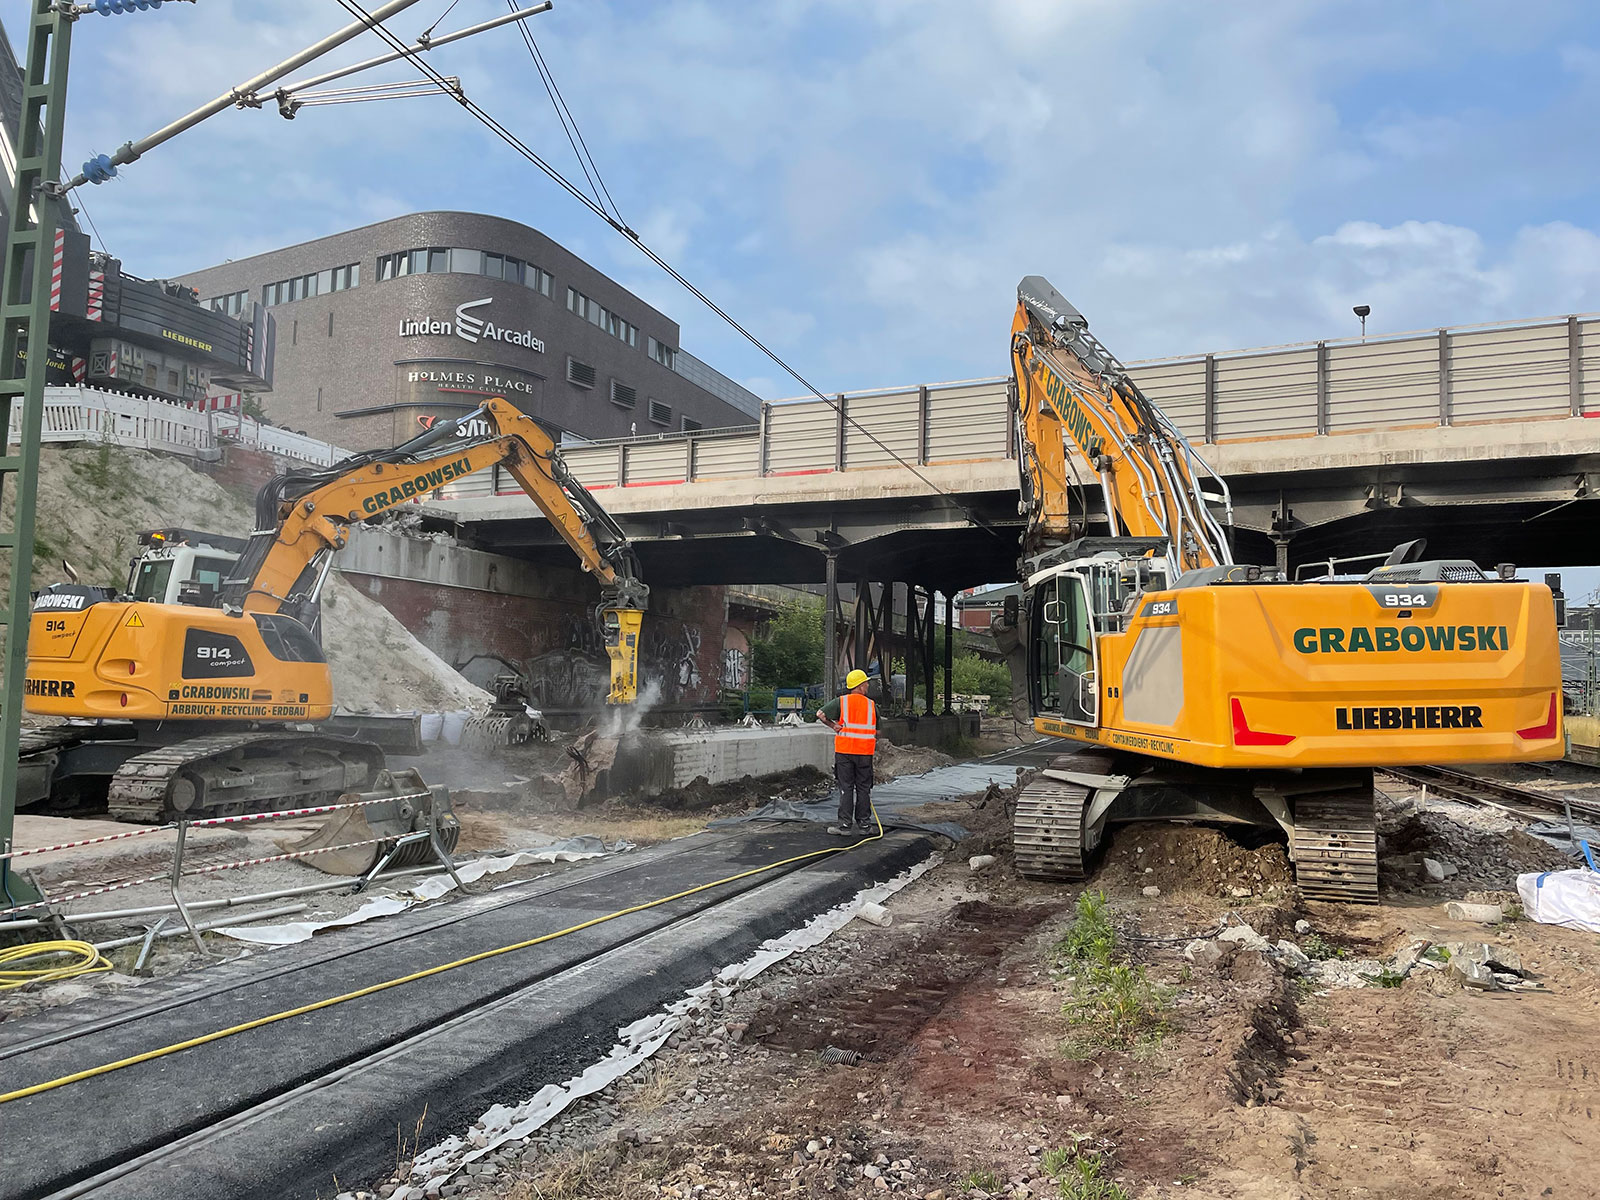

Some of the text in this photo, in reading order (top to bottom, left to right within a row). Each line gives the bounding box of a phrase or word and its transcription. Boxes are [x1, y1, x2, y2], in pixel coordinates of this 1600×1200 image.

[162, 329, 212, 352] LIEBHERR
[399, 317, 545, 354] Linden Arcaden
[408, 371, 533, 394] HOLMES PLACE
[362, 457, 472, 513] GRABOWSKI
[1385, 594, 1427, 606] 934
[1152, 603, 1171, 615] 934
[45, 620, 65, 631] 914
[1293, 626, 1509, 654] GRABOWSKI
[197, 647, 232, 659] 914
[210, 658, 246, 667] compact
[182, 685, 250, 700] GRABOWSKI
[171, 704, 216, 715] ABBRUCH
[221, 705, 267, 716] RECYCLING
[272, 706, 306, 716] ERDBAU
[1336, 706, 1484, 730] LIEBHERR
